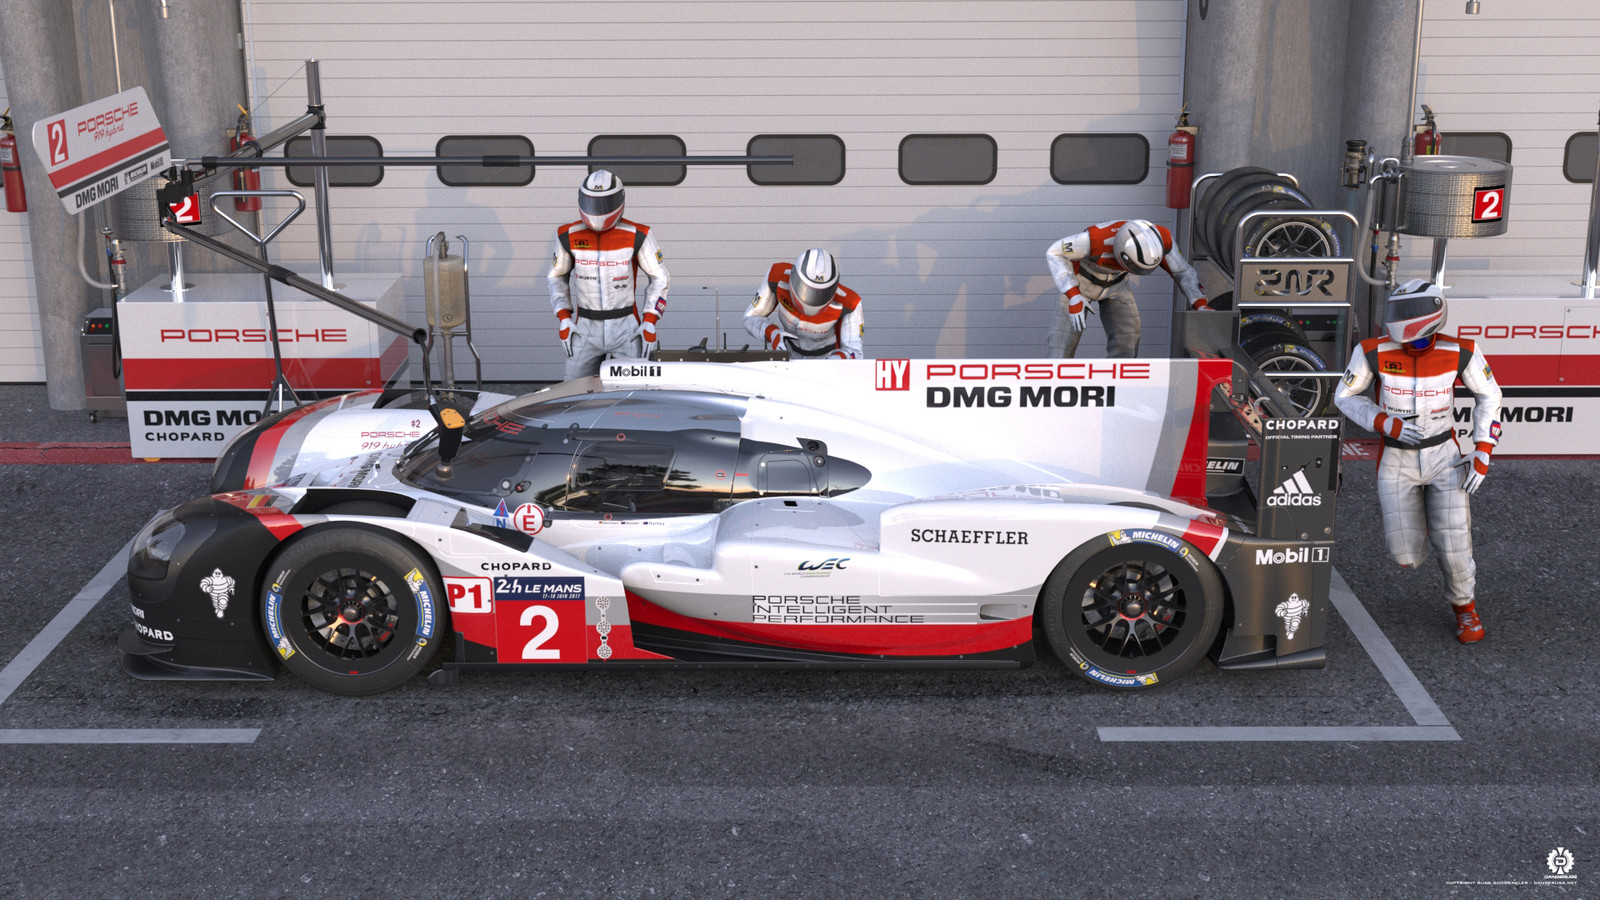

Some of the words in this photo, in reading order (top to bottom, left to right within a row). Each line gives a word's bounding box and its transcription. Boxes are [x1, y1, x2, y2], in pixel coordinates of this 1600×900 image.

[77, 101, 138, 137] PORSCHE
[52, 123, 66, 163] 2
[75, 187, 97, 209] DMG
[97, 176, 119, 199] MORI
[1481, 191, 1500, 218] 2
[575, 259, 630, 267] PORSCHE
[160, 329, 347, 342] PORSCHE
[610, 366, 647, 377] Mobil
[649, 366, 661, 377] 1
[877, 360, 909, 390] HY
[926, 363, 1150, 380] PORSCHE
[926, 386, 1011, 408] DMG
[1019, 386, 1115, 408] MORI
[143, 410, 211, 426] DMG
[1500, 407, 1574, 423] MORI
[411, 419, 421, 428] #2
[1265, 419, 1339, 430] CHOPARD
[145, 432, 225, 442] CHOPARD
[361, 441, 381, 449] 919
[1206, 460, 1239, 470] ELIN
[1266, 493, 1322, 506] adidas
[496, 518, 506, 529] N
[523, 514, 536, 531] E
[911, 529, 1029, 545] SCHAEFFLER
[1132, 531, 1179, 549] MICHELIN
[1255, 547, 1309, 565] Mobil
[481, 562, 552, 571] CHOPARD
[798, 558, 851, 571] WEC
[495, 579, 522, 594] 24h
[524, 585, 542, 593] LE
[543, 584, 582, 593] MANS
[447, 583, 482, 609] P1
[752, 595, 860, 604] PORSCHE
[268, 594, 280, 639] MICHELIN
[419, 590, 430, 636] MICHELIN
[752, 605, 893, 614] INTELLIGENT
[752, 615, 924, 623] PERFORMANCE
[519, 604, 561, 660] 2
[1088, 669, 1136, 685] MICHELIN
